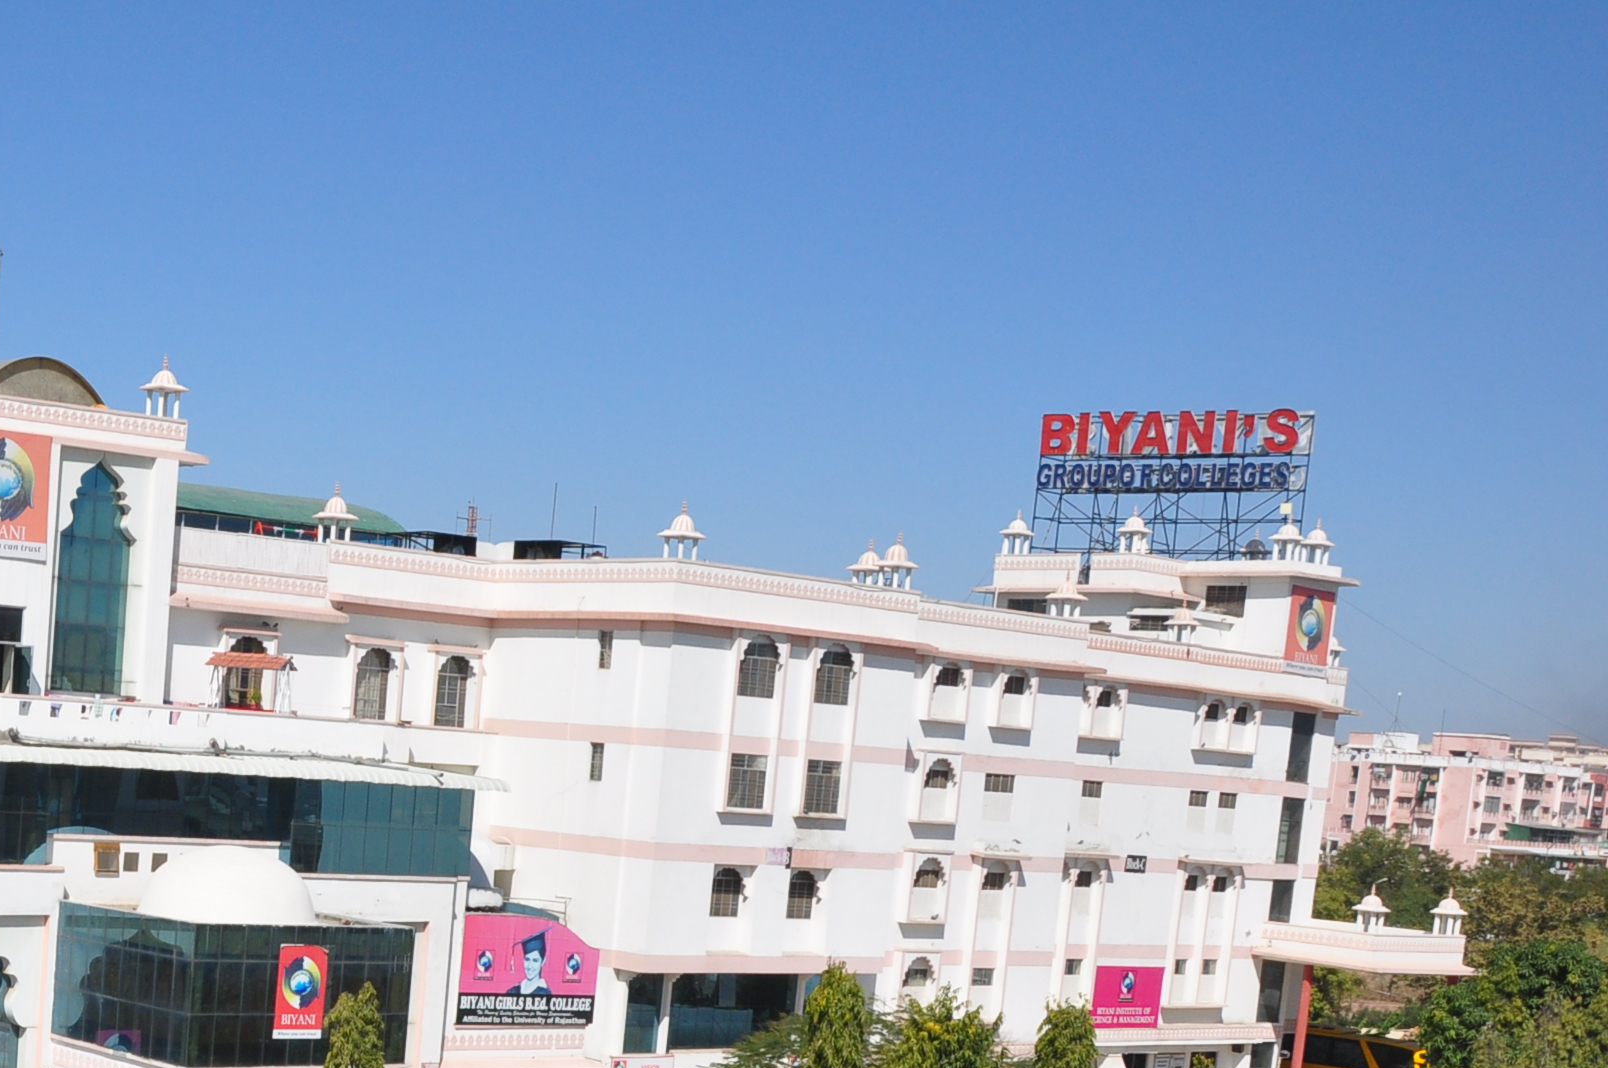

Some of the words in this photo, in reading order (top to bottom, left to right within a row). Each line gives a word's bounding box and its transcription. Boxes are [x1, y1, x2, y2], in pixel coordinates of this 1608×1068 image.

[1040, 408, 1300, 456] BIYANI'S
[1037, 463, 1119, 490] GROUP
[1158, 461, 1290, 489] COLLEGES
[3, 543, 19, 551] can
[20, 544, 42, 554] trust
[1295, 651, 1319, 665] BIYANI
[460, 995, 496, 1010] BIYANI
[495, 995, 525, 1011] GIRLS
[525, 996, 549, 1011] B.Ed.
[550, 997, 592, 1012] COLLEGE
[280, 1013, 317, 1026] BIYANI
